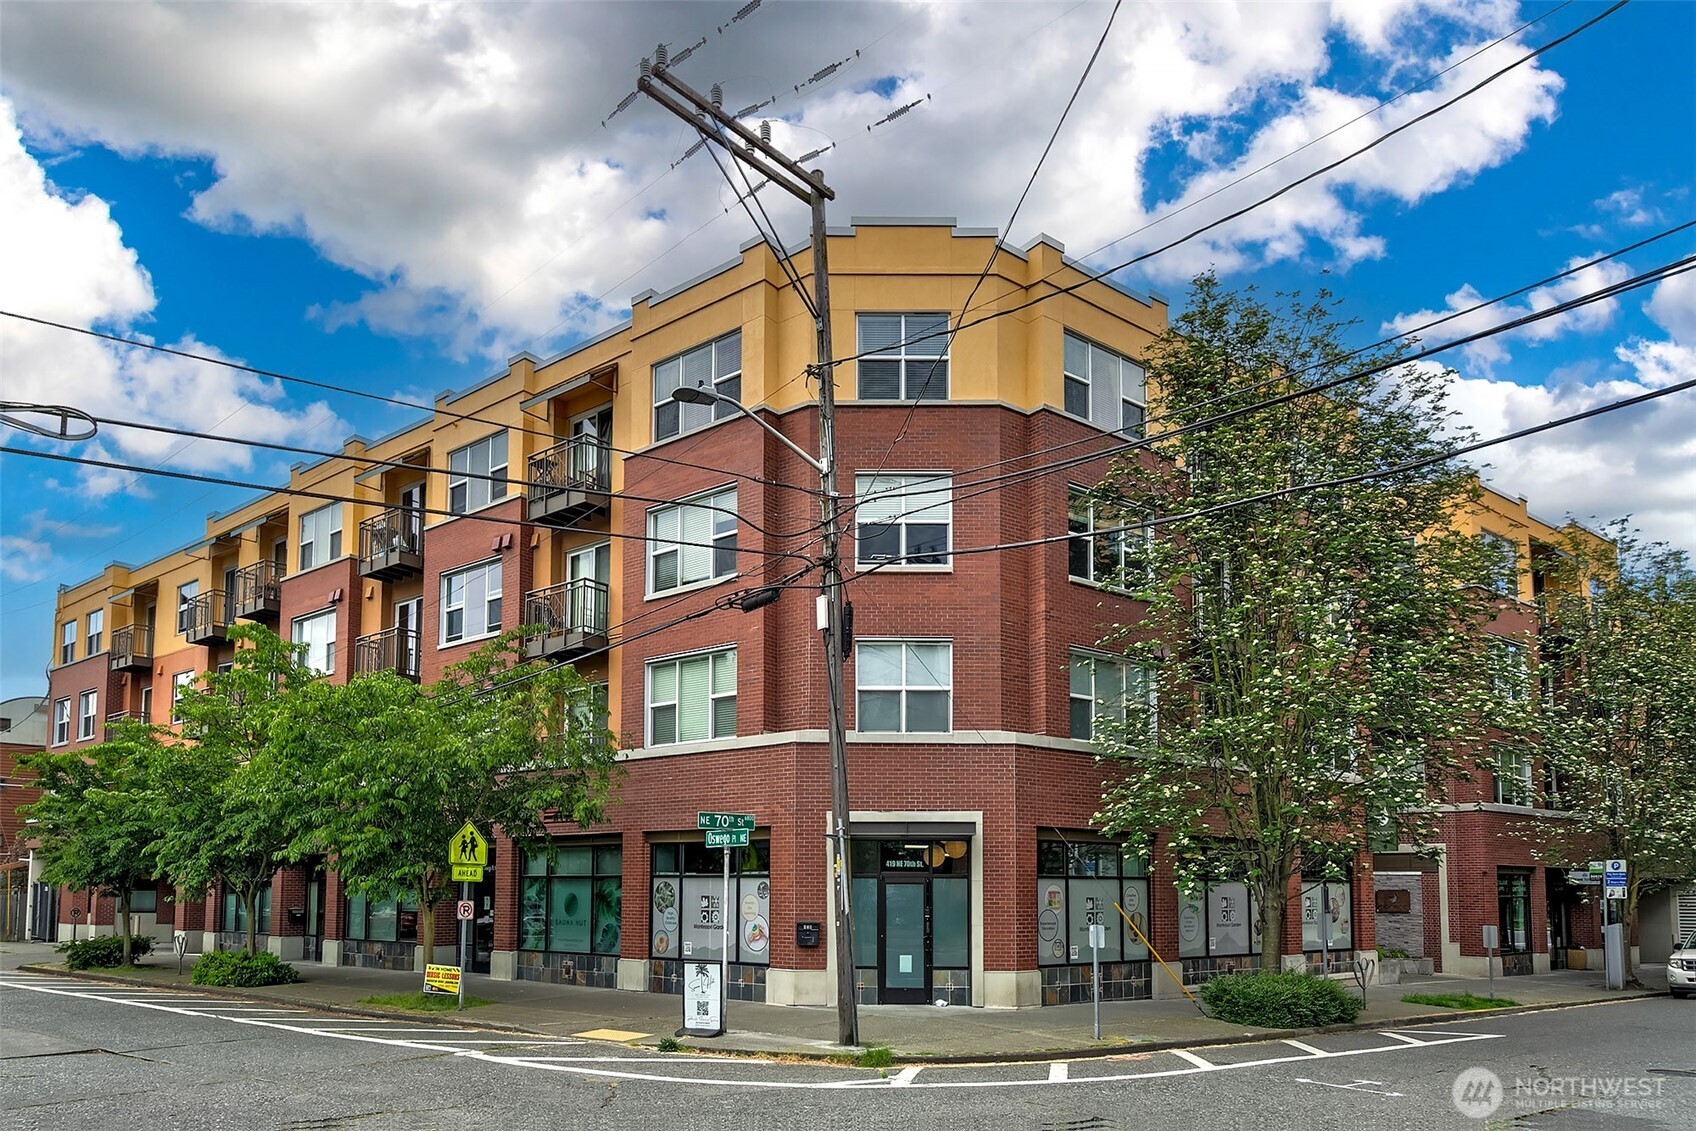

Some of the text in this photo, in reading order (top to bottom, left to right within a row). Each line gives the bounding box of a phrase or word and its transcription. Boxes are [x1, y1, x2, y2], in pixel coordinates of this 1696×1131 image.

[700, 816, 710, 824] NE
[714, 814, 735, 827] 70th
[737, 818, 744, 826] St
[708, 832, 731, 846] Oswego
[740, 833, 747, 843] NE
[886, 860, 896, 868] 419
[896, 860, 903, 868] NE
[904, 860, 916, 868] 70th
[458, 869, 478, 877] AHEAD
[442, 972, 460, 980] LESSONS
